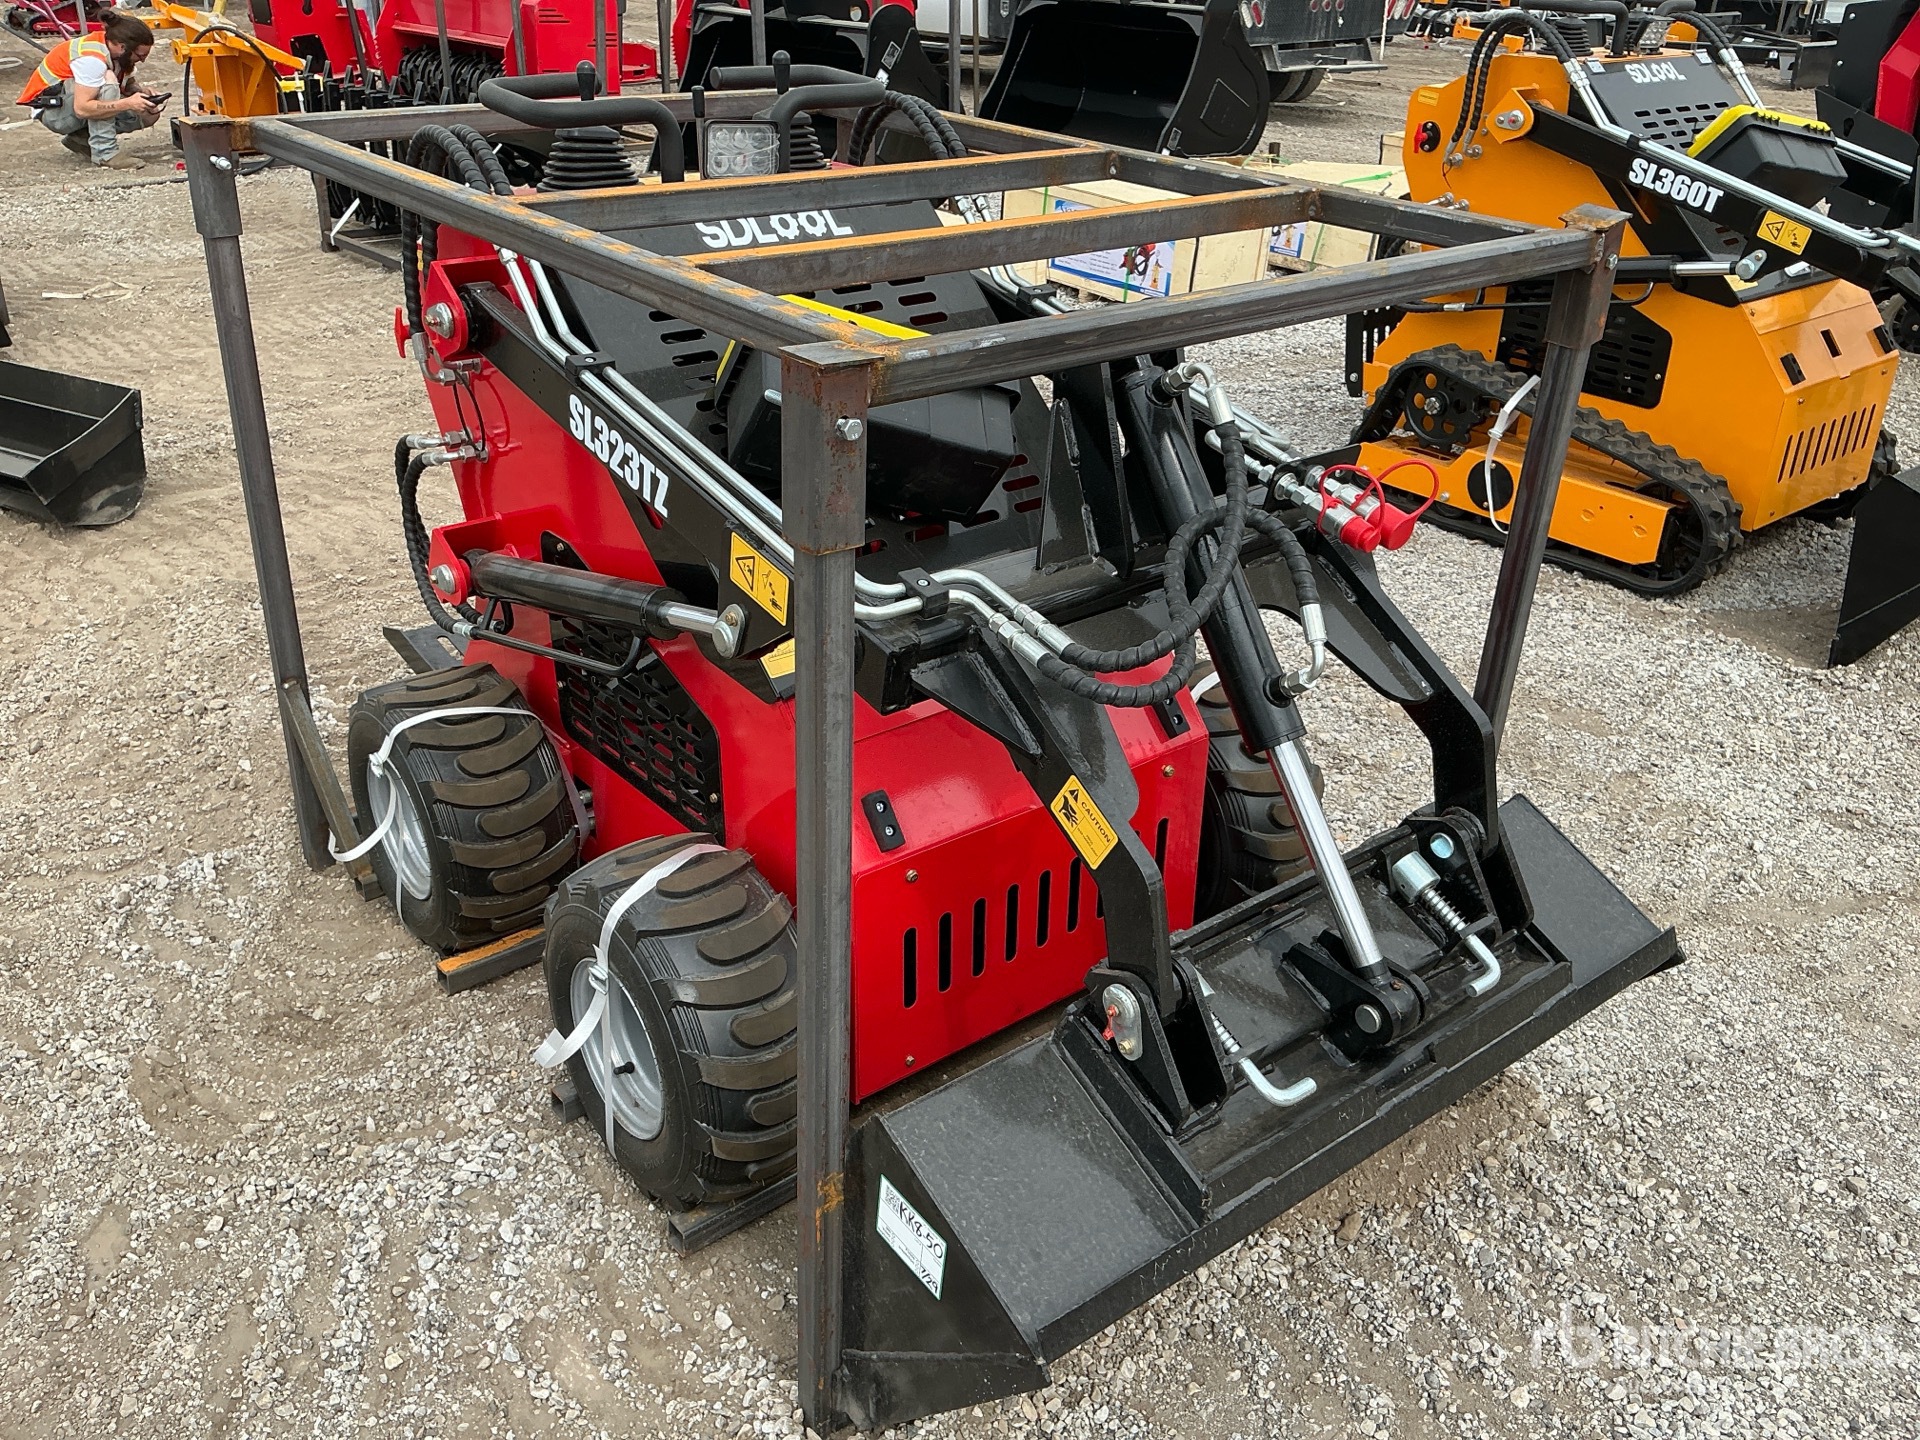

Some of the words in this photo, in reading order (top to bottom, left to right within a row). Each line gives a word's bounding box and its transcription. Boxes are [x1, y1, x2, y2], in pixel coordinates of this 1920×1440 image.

[1624, 61, 1687, 83] SDLOOL
[1628, 158, 1724, 213] SL360T
[695, 209, 854, 248] SDLOOL
[569, 394, 669, 518] SL323TZ
[1081, 802, 1111, 843] CAUTION
